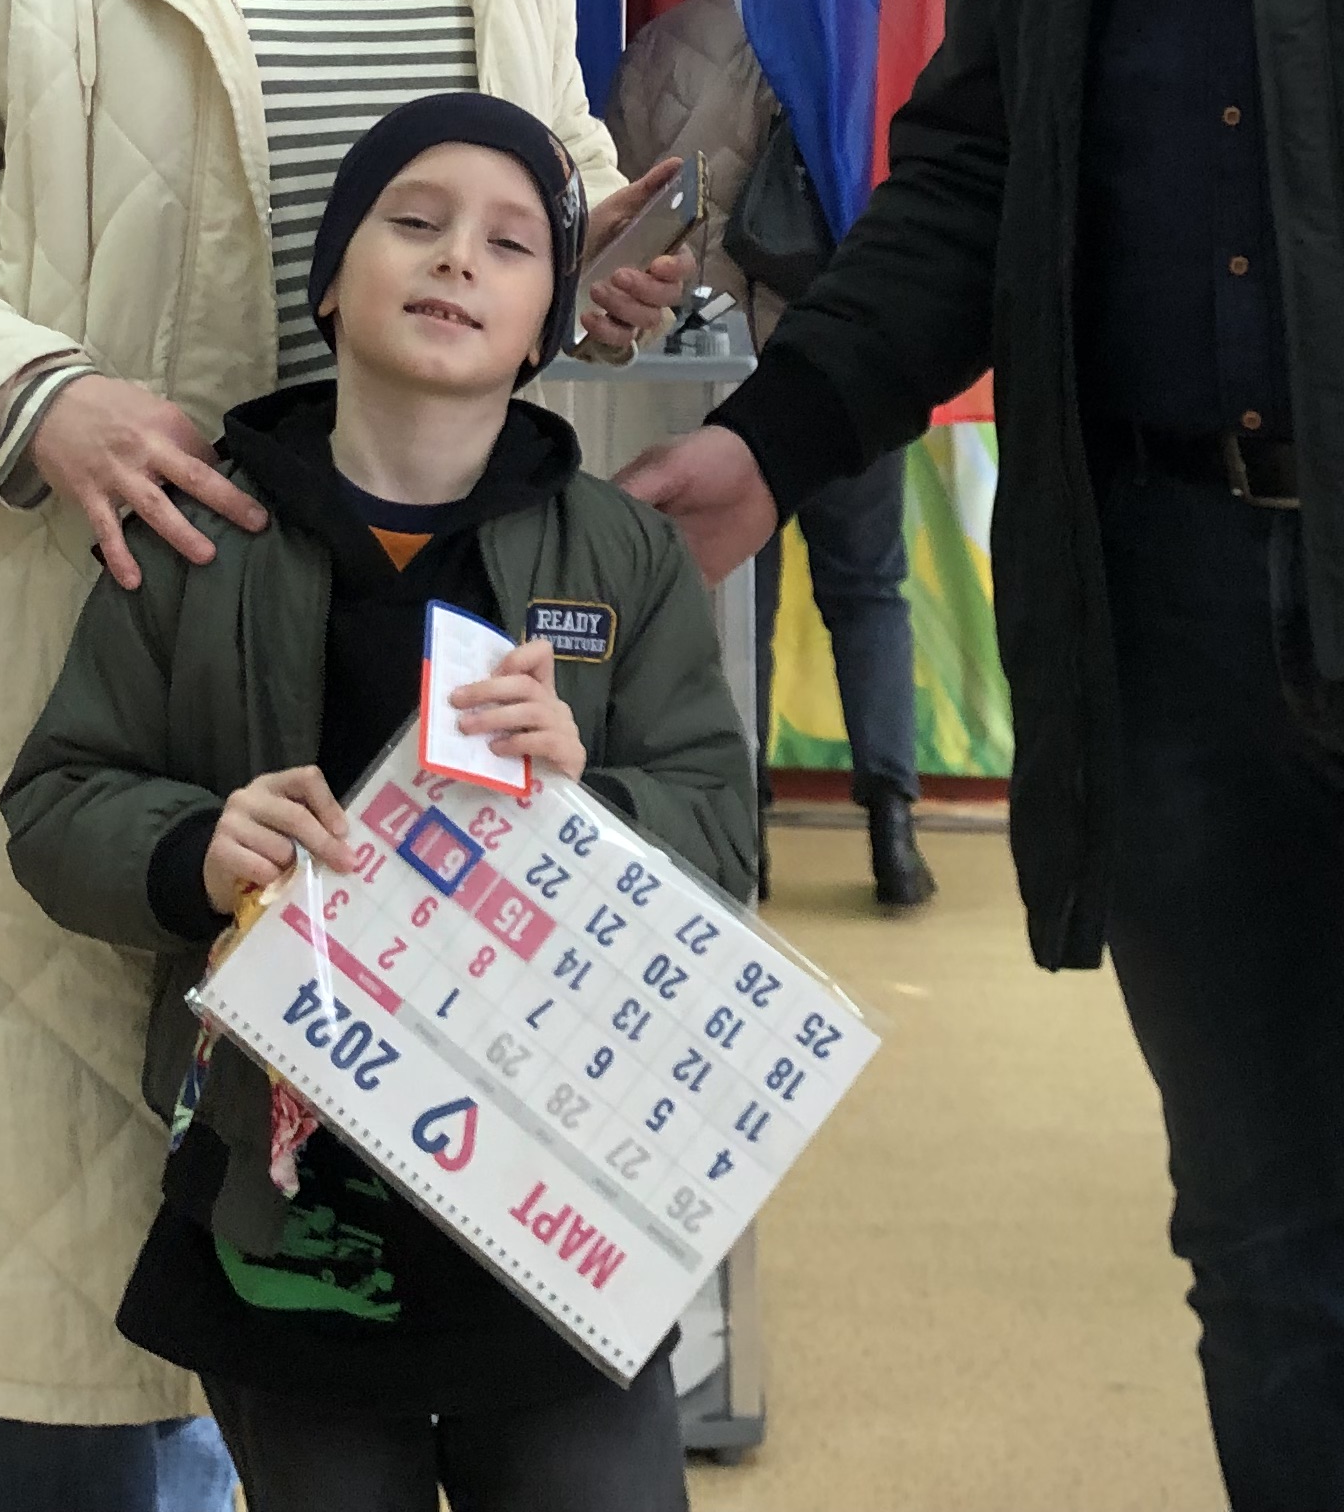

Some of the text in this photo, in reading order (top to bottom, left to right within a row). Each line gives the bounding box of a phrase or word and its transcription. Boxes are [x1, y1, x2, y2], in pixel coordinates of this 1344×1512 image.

[531, 633, 607, 653] VENTURE
[537, 609, 603, 634] READY
[379, 804, 417, 841] 17
[467, 805, 513, 851] 23
[557, 813, 598, 857] 29
[525, 853, 570, 899] 22
[616, 861, 661, 906] 28
[322, 888, 349, 920] 3
[493, 897, 533, 940] 15
[584, 904, 626, 946] 21
[377, 936, 408, 970] 2
[674, 914, 719, 955] 27
[552, 947, 592, 990] 14
[642, 953, 688, 999] 20
[734, 961, 781, 1007] 26
[345, 842, 733, 1180] 4 5 6 7 8 9 10
[436, 987, 459, 1018] 1
[611, 998, 651, 1040] 13
[704, 1006, 744, 1049] 19
[795, 1012, 841, 1059] 25
[485, 1032, 532, 1078] 29
[672, 1047, 711, 1092] 12
[765, 1057, 804, 1100] 18
[545, 1082, 591, 1129] 28
[734, 1100, 769, 1142] 11
[282, 978, 625, 1289] МАРТ 2024
[604, 1137, 651, 1180] 27
[665, 1185, 712, 1234] 26
